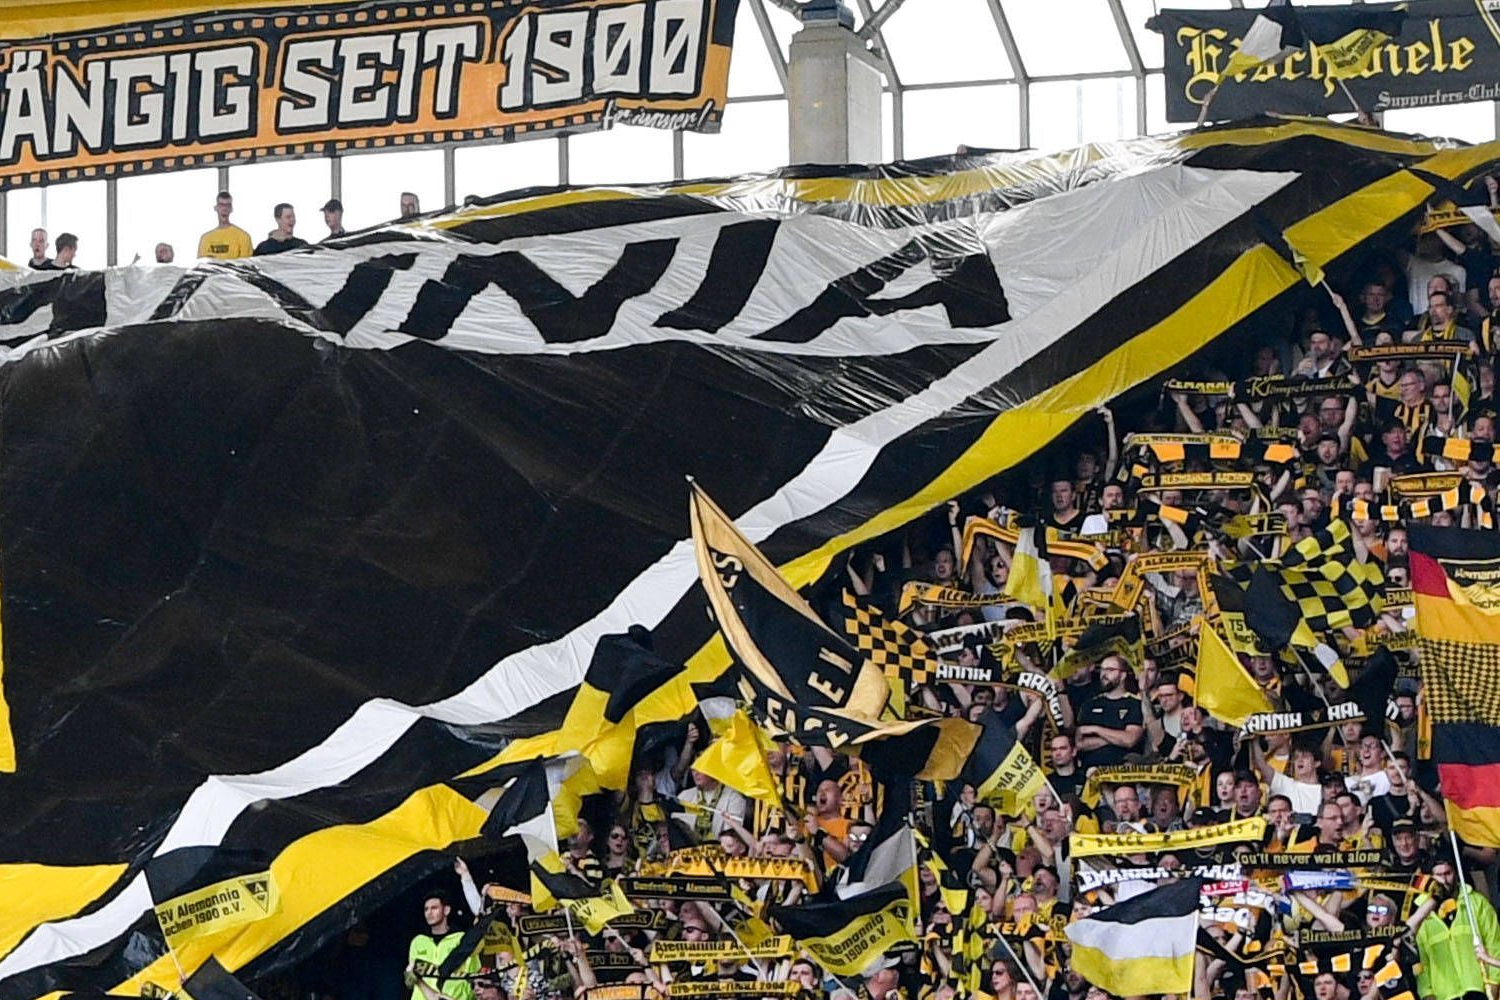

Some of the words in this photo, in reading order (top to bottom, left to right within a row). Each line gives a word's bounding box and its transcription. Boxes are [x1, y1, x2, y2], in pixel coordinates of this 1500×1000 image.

[279, 25, 482, 129] SEIT
[501, 0, 703, 109] 1900
[1274, 855, 1310, 865] never
[1314, 853, 1344, 865] walk
[1347, 850, 1381, 864] alone
